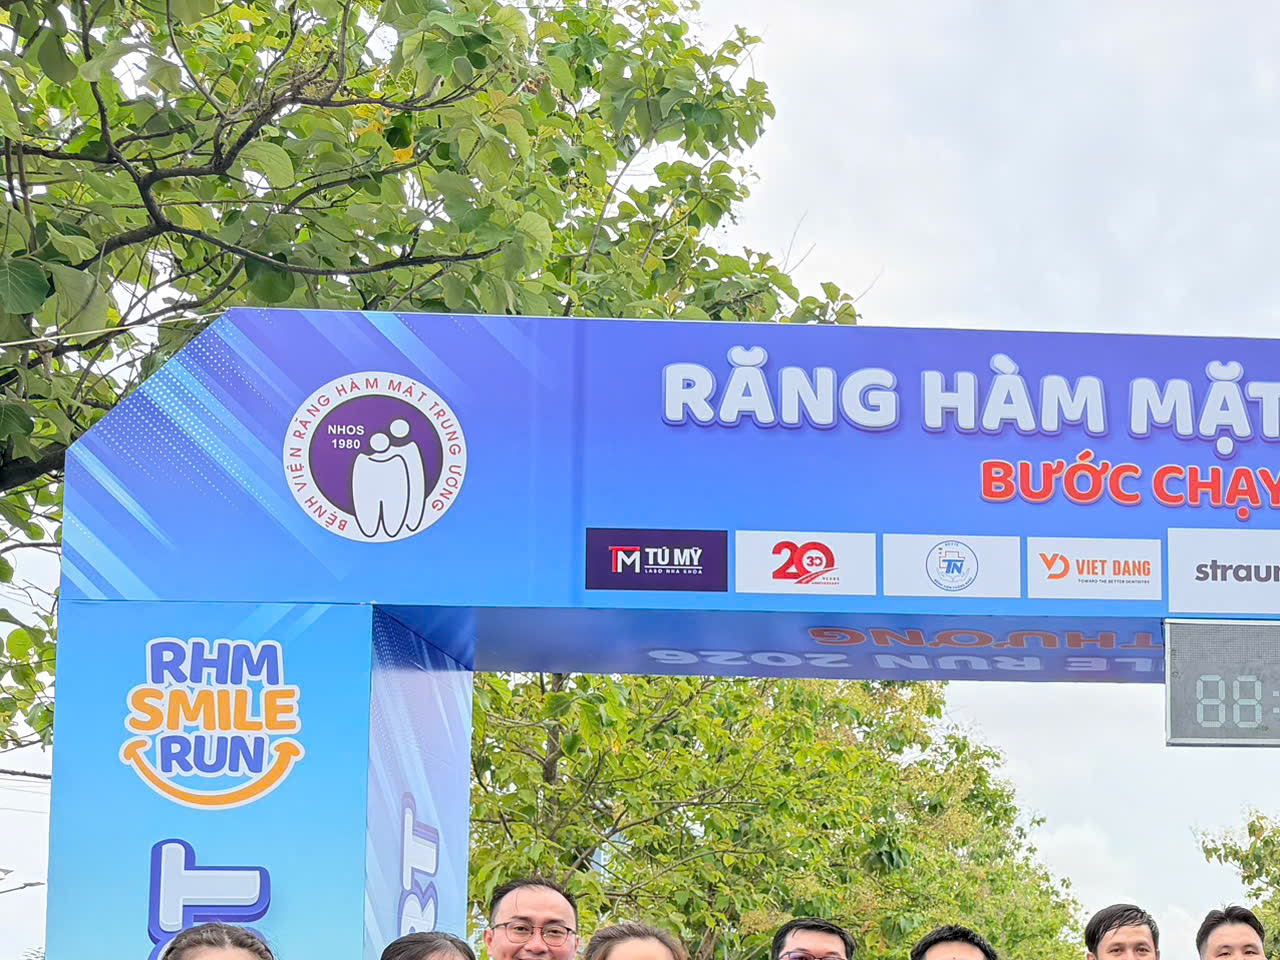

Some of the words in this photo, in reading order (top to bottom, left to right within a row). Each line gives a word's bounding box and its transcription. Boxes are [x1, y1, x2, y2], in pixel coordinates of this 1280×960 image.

[335, 377, 379, 397] HÀM
[387, 379, 428, 403] MẶT
[663, 346, 898, 430] RĂNG
[922, 354, 1107, 436] HÀM
[293, 394, 331, 441] RĂNG
[327, 425, 365, 436] NHOS
[428, 401, 462, 456] TRUNG
[331, 439, 361, 449] 1980
[287, 447, 307, 492] VIỆN
[431, 464, 462, 513] ƯƠNG
[981, 450, 1142, 504] BƯỚC
[305, 496, 348, 532] BỆNH
[645, 546, 669, 565] TÚ
[673, 547, 703, 566] MỸ
[1075, 559, 1107, 577] VIET
[1112, 560, 1152, 577] DANG
[149, 641, 280, 686] RHM
[127, 686, 298, 732] SMILE
[158, 735, 264, 774] RUN
